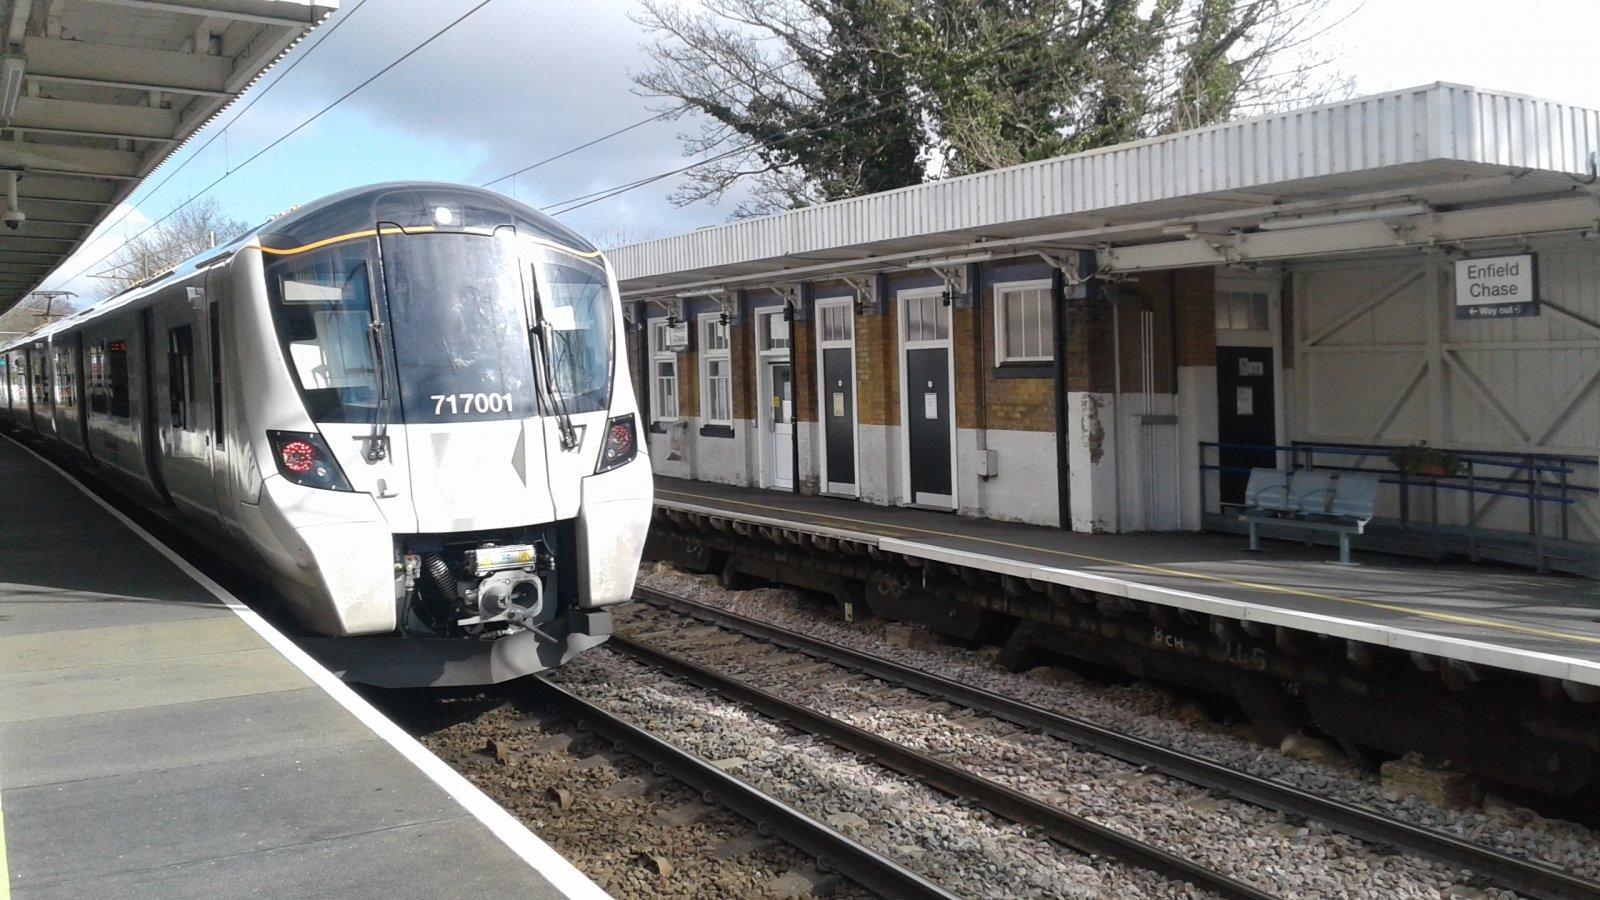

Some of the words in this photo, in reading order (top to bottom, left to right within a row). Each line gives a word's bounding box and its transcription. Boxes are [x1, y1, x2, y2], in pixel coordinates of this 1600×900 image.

[1467, 262, 1519, 279] Enfield
[1469, 283, 1518, 297] Chase
[1479, 306, 1497, 316] Way
[1499, 306, 1514, 314] out
[430, 392, 513, 415] 717001
